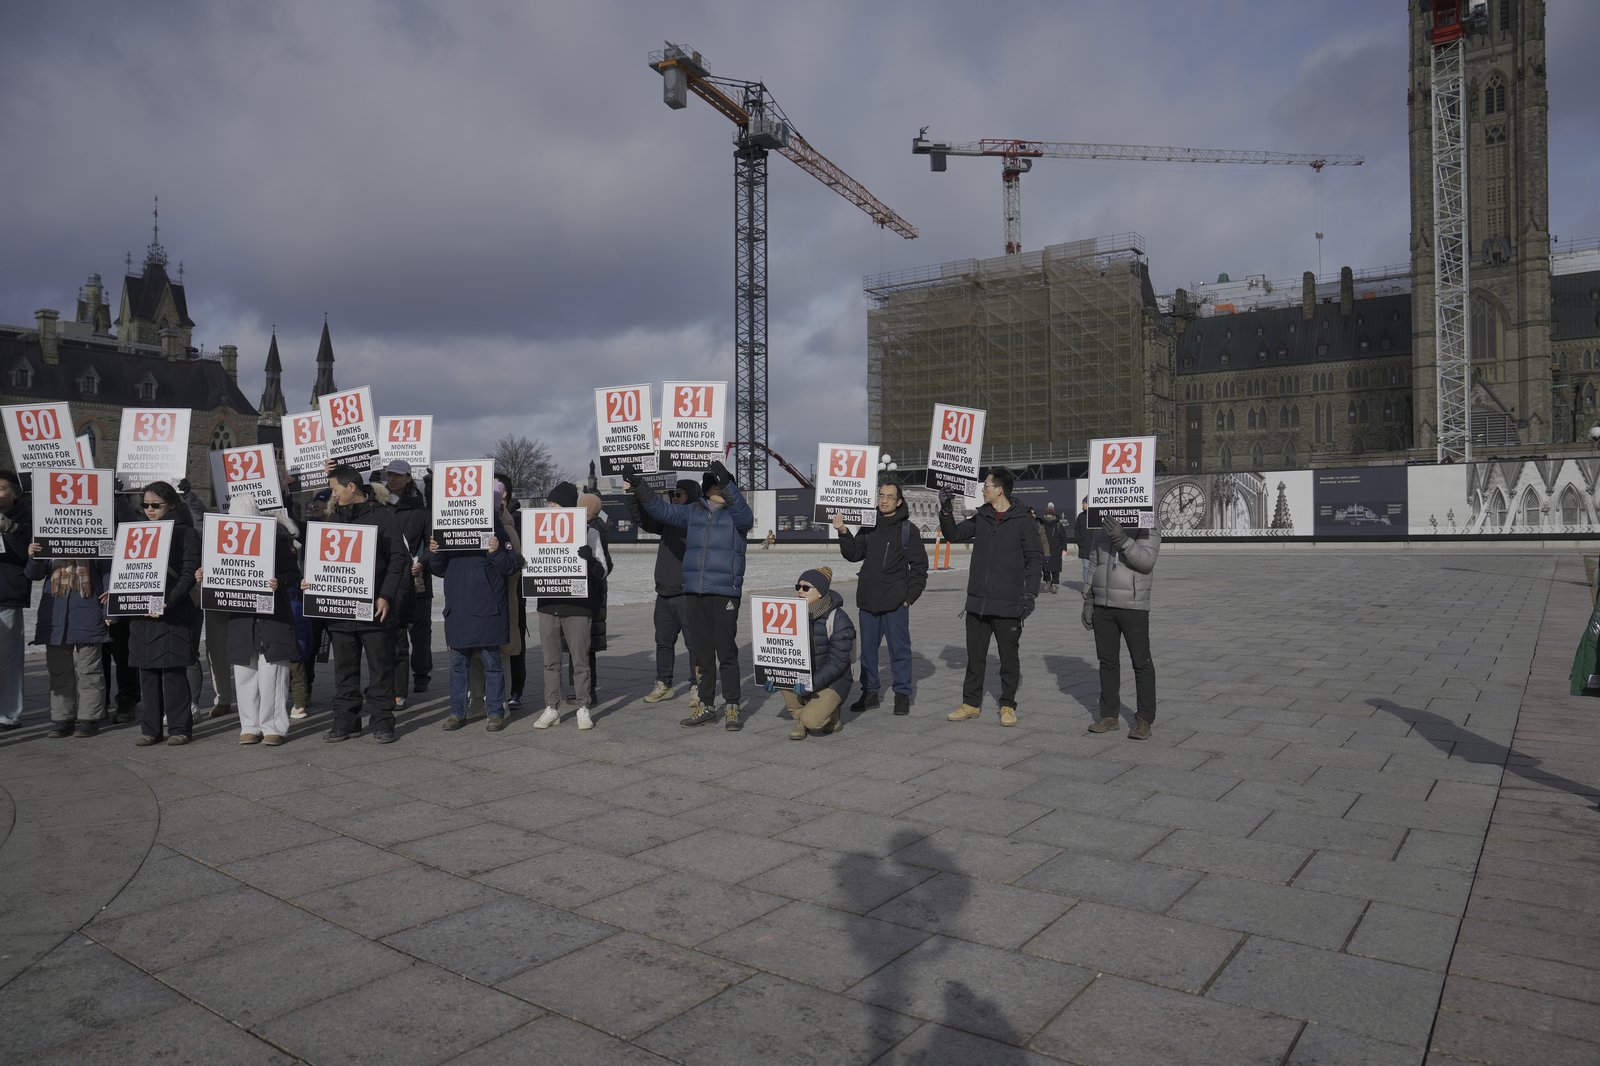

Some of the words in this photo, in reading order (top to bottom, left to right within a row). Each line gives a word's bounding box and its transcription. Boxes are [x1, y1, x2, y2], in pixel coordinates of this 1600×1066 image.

[609, 391, 637, 422] 20
[679, 387, 708, 416] 31
[333, 395, 358, 426] 38
[21, 410, 55, 440] 90
[138, 414, 171, 441] 39
[611, 426, 638, 434] MONTHS
[945, 412, 970, 442] 30
[298, 418, 322, 444] 37
[336, 426, 361, 436] MONTHS
[392, 421, 416, 441] 41
[332, 436, 356, 446] WAITING
[605, 435, 631, 443] WAITING
[681, 440, 719, 448] RESPONSE
[28, 443, 60, 451] MONTHS
[300, 444, 326, 454] MONTHS
[330, 446, 342, 455] IRCC
[343, 440, 374, 452] RESPONSE
[602, 444, 616, 452] IRCC
[617, 443, 650, 451] RESPONSE
[943, 444, 967, 454] MONTHS
[22, 451, 54, 460] WAITING
[293, 454, 321, 463] WAITING
[346, 454, 371, 464] TIMELINES
[936, 452, 959, 462] WAITING
[961, 456, 972, 464] FOR
[1106, 443, 1137, 473] 23
[38, 459, 77, 468] RESPONSE
[228, 452, 261, 480] 32
[290, 464, 304, 472] IRCC
[305, 461, 326, 470] RESPO
[834, 450, 862, 477] 37
[932, 460, 944, 468] IRCC
[944, 462, 975, 474] RESPONSE
[448, 467, 477, 496] 38
[55, 474, 92, 504] 31
[232, 482, 262, 492] MONTHS
[836, 496, 871, 504] RESPONSE
[55, 508, 92, 516] MONTHS
[45, 517, 83, 525] WAITING
[539, 514, 569, 543] 40
[128, 528, 158, 558] 37
[222, 522, 256, 554] 37
[325, 530, 358, 561] 37
[126, 562, 152, 570] MONTHS
[221, 558, 255, 567] MONTHS
[213, 567, 245, 576] WAITING
[323, 565, 356, 574] MONTHS
[118, 572, 144, 580] WAITING
[315, 574, 346, 583] WAITING
[128, 581, 161, 589] RESPONSE
[207, 577, 224, 585] IRCC
[226, 579, 268, 588] RESPONSE
[327, 585, 368, 594] RESPONSE
[229, 600, 256, 608] RESULTS
[766, 603, 793, 634] 22
[767, 638, 793, 646] MONTHS
[760, 646, 787, 655] WAITING
[772, 657, 806, 666] RESPONSE
